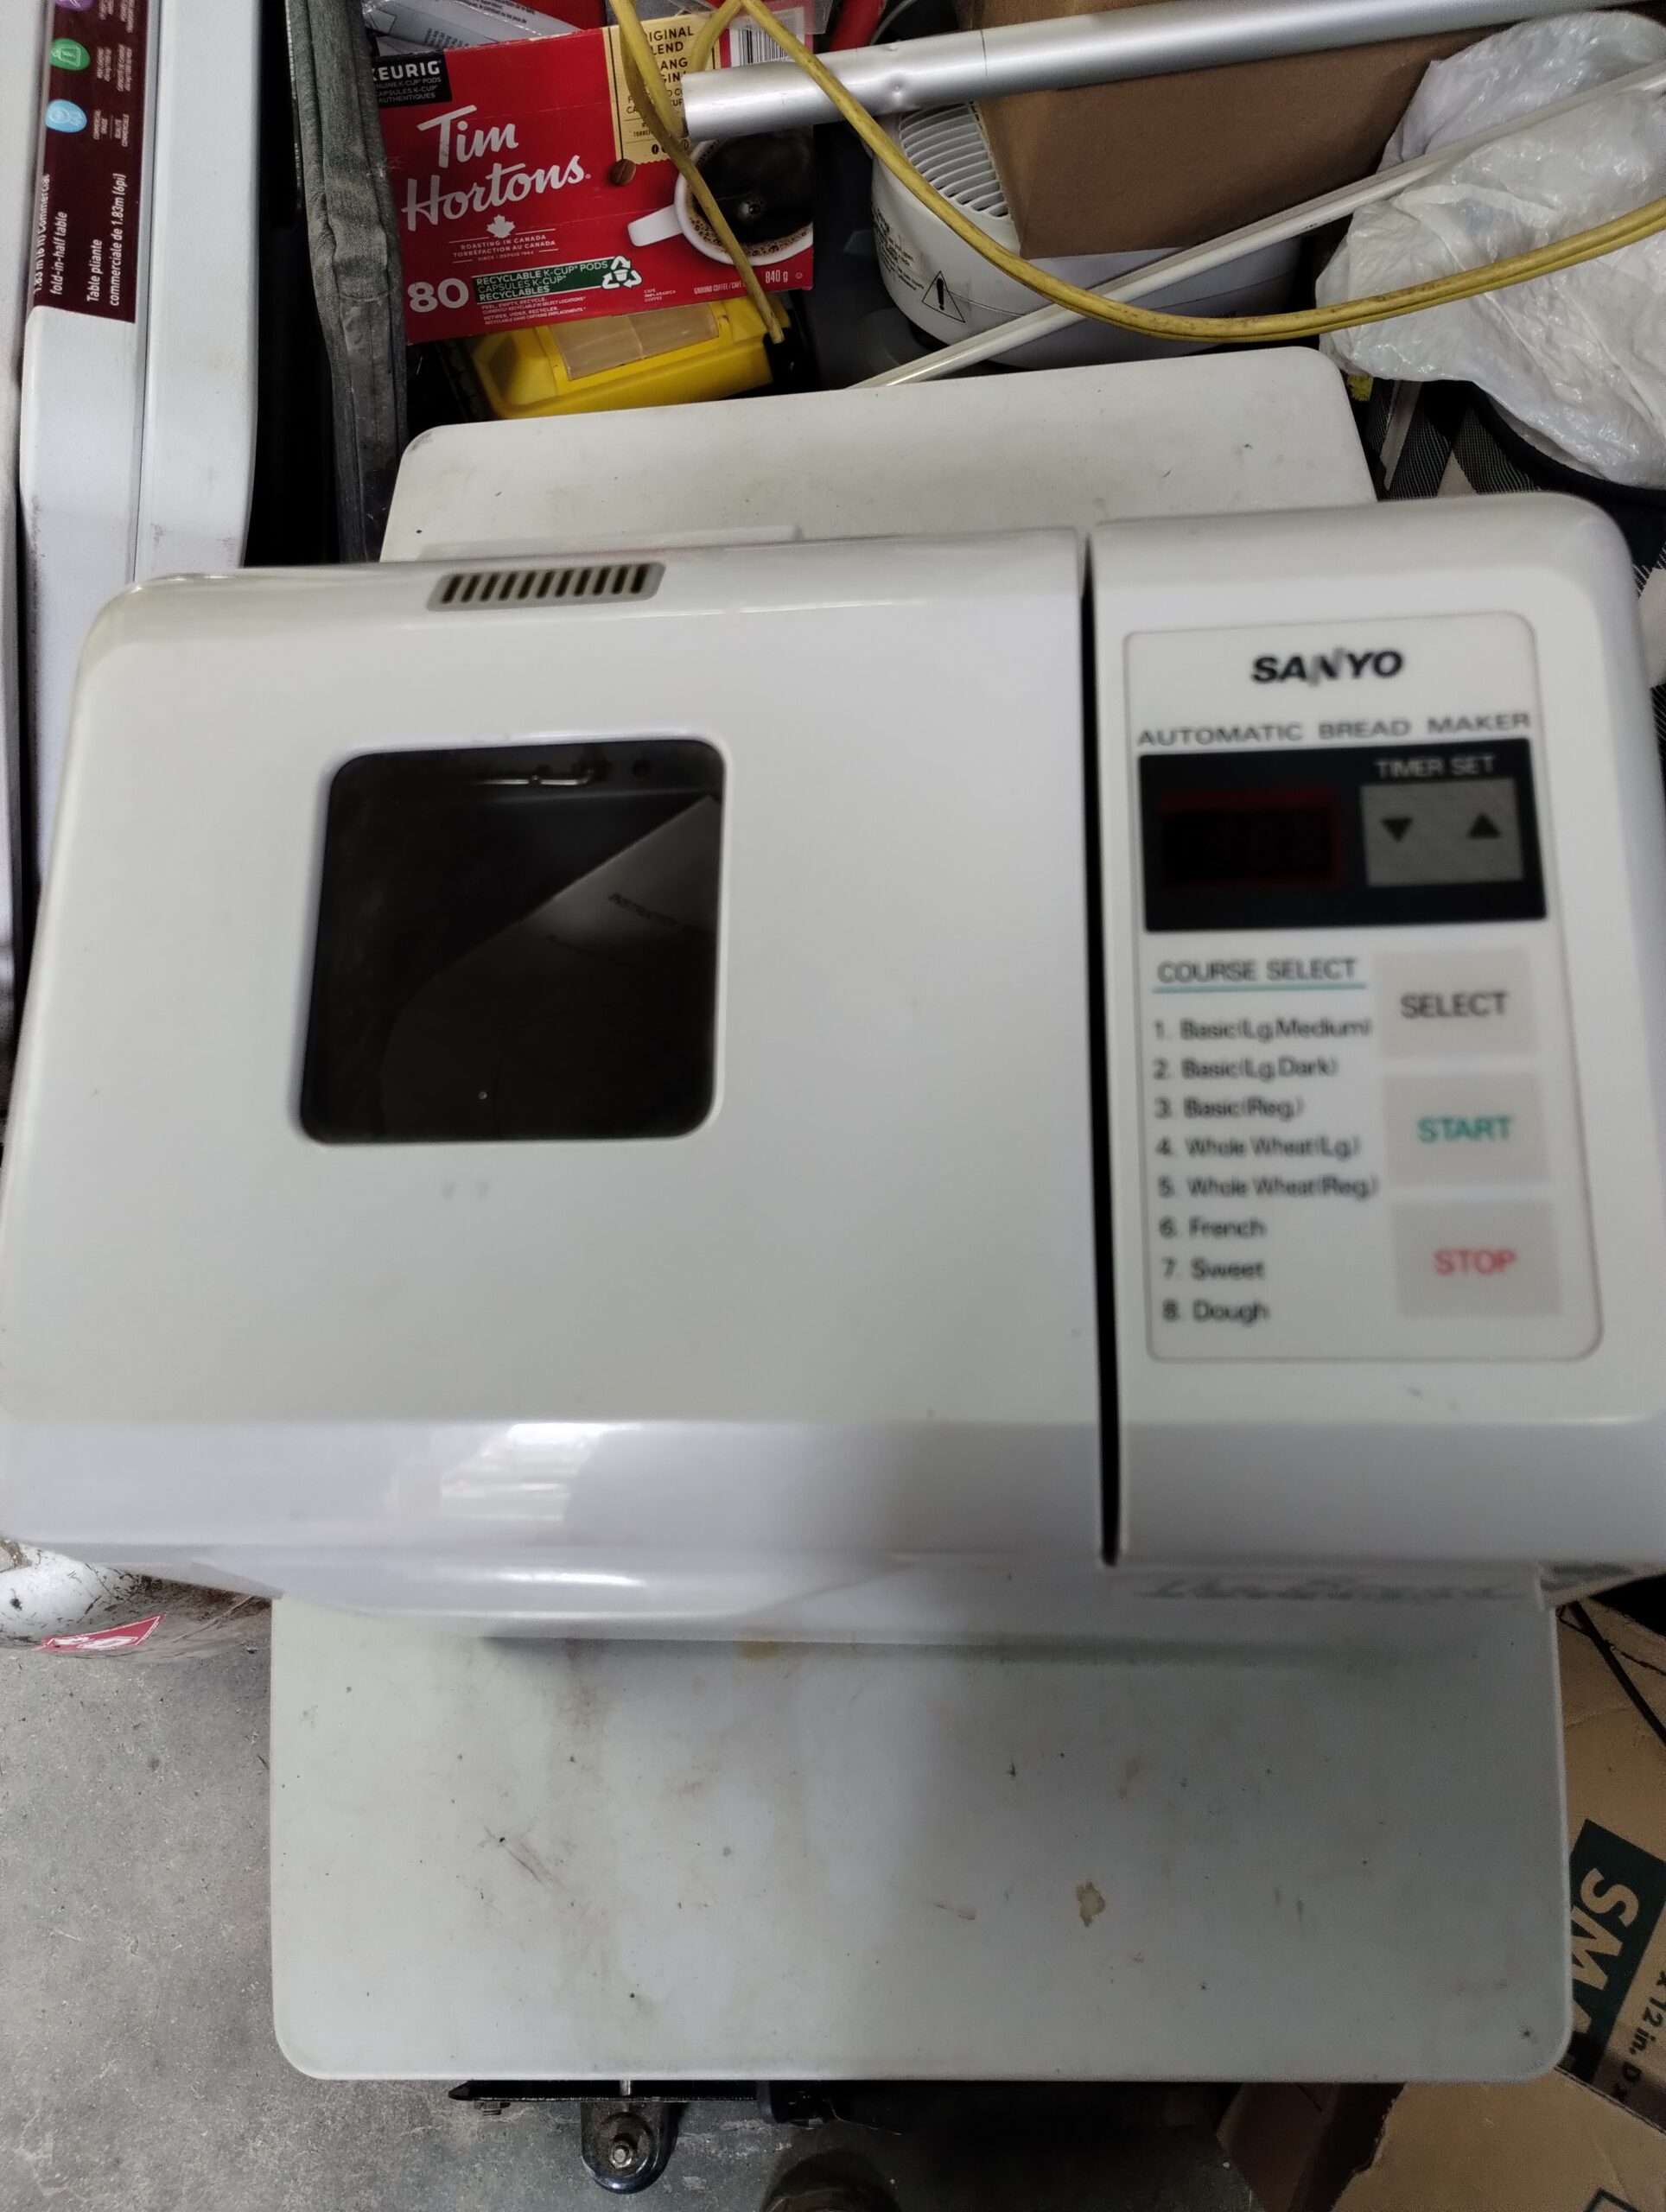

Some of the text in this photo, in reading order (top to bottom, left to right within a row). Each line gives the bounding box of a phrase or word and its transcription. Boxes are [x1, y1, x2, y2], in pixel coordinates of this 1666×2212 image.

[650, 26, 694, 41] IGINAL
[652, 41, 684, 55] LEND
[378, 87, 414, 97] APSULES
[416, 105, 518, 168] Tim
[110, 173, 128, 307] commerciale de 1.83m (6pi)
[461, 240, 501, 251] ROASTING
[513, 234, 547, 245] CANADA
[524, 240, 556, 250] CANADA
[49, 211, 67, 296] fold-in-half table
[86, 238, 104, 302] Table pliante
[476, 270, 542, 286] RECYCLABLE
[580, 260, 607, 272] PODS
[766, 270, 788, 283] 840 g
[407, 277, 469, 313] 80
[478, 279, 531, 294] CAPSULES
[479, 285, 550, 302] RECYCLABLES
[1251, 647, 1405, 687] SANYO
[1137, 712, 1531, 747] AUTOMATIC BREAD MAKER
[1376, 754, 1497, 778] TIMER SET
[1157, 957, 1358, 985] COURSE SELECT
[1400, 992, 1510, 1019] SELECT
[1154, 1020, 1167, 1040] 1.
[1153, 1059, 1172, 1080] 2.
[1154, 1099, 1173, 1120] 3.
[1417, 1116, 1513, 1142] START
[1155, 1138, 1173, 1158] 4.
[1185, 1137, 1247, 1158] Whole
[1158, 1178, 1176, 1198] 5.
[1187, 1177, 1249, 1198] Whole
[1159, 1217, 1269, 1238] 6. French
[1190, 1258, 1265, 1281] Sweet
[1434, 1248, 1518, 1275] STOP
[1162, 1299, 1270, 1327] 8. Dough
[1642, 1996, 1666, 2028] 12
[1629, 2026, 1657, 2056] in.
[1623, 2061, 1643, 2083] D
